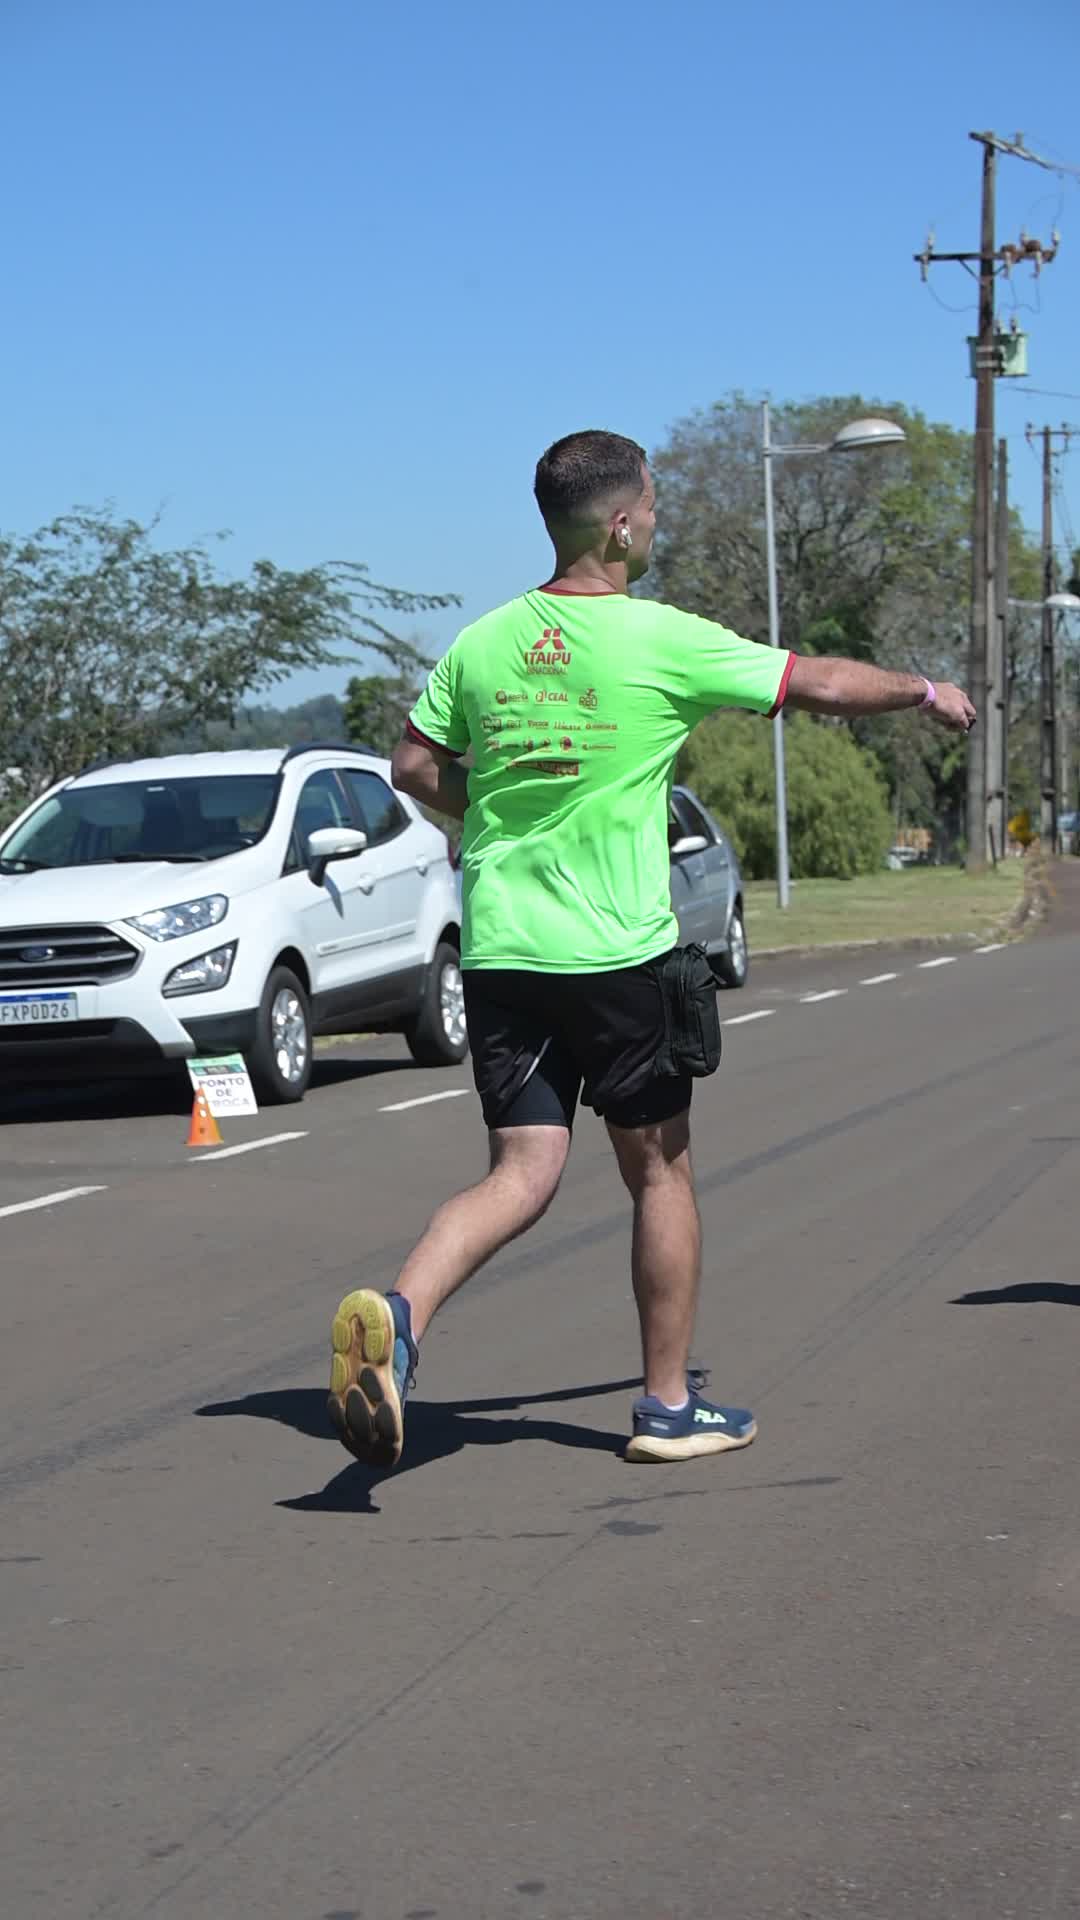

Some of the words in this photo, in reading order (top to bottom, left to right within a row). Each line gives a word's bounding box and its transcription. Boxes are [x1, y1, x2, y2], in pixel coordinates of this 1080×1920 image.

[524, 652, 571, 665] ITAIPU
[548, 692, 568, 702] CEAL
[198, 1077, 245, 1089] PONTO
[215, 1088, 232, 1097] DE
